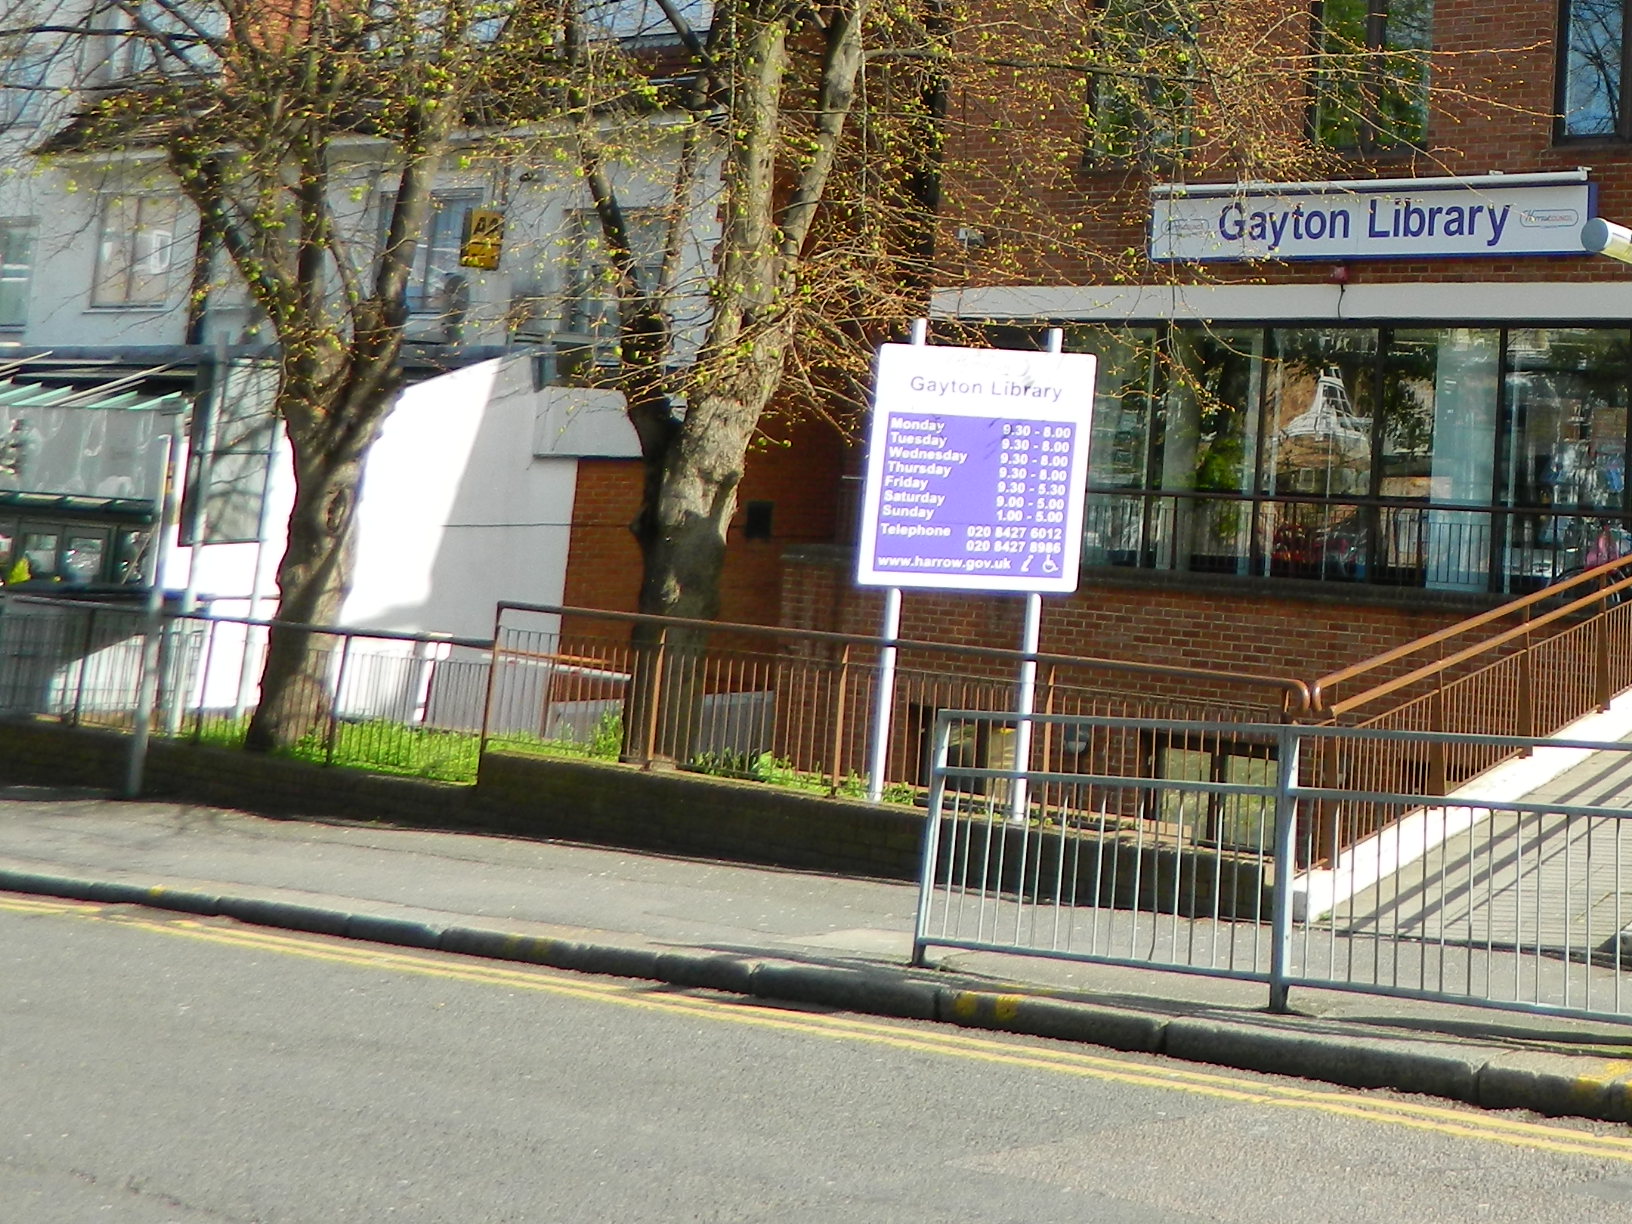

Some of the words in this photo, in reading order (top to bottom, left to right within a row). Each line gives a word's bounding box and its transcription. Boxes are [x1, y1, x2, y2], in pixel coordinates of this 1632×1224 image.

[1218, 202, 1350, 250] Gayton
[1368, 196, 1511, 246] Library
[910, 376, 982, 396] Gayton
[991, 381, 1062, 402] Library
[891, 418, 945, 433] Monday
[1003, 424, 1031, 436] 9.30
[1043, 426, 1071, 438] 8.00
[891, 432, 947, 448] Tuesday
[1002, 438, 1030, 451] 9.30
[1042, 440, 1070, 453] 8.00
[889, 447, 968, 464] Wednesday
[1000, 453, 1028, 465] 9.30
[1041, 455, 1069, 467] 8.00
[888, 461, 952, 478] Thursday
[999, 467, 1027, 479] 9.30
[1039, 469, 1067, 482] 8.00
[885, 475, 928, 491] Friday
[998, 481, 1026, 494] 9.30
[1038, 483, 1066, 496] 5.30
[884, 490, 945, 506] Saturday
[996, 496, 1025, 508] 9.00
[1037, 497, 1065, 510] 5.00
[882, 504, 934, 520] Sunday
[997, 510, 1023, 522] 1.00
[1035, 511, 1064, 524] 5.00
[881, 523, 951, 538] Telephone
[967, 526, 991, 538] 020
[995, 527, 1026, 539] 8427
[1030, 528, 1062, 540] 6012
[966, 540, 990, 552] 020
[994, 541, 1025, 553] 8427
[878, 556, 1011, 572] www.harrow.gov.uk
